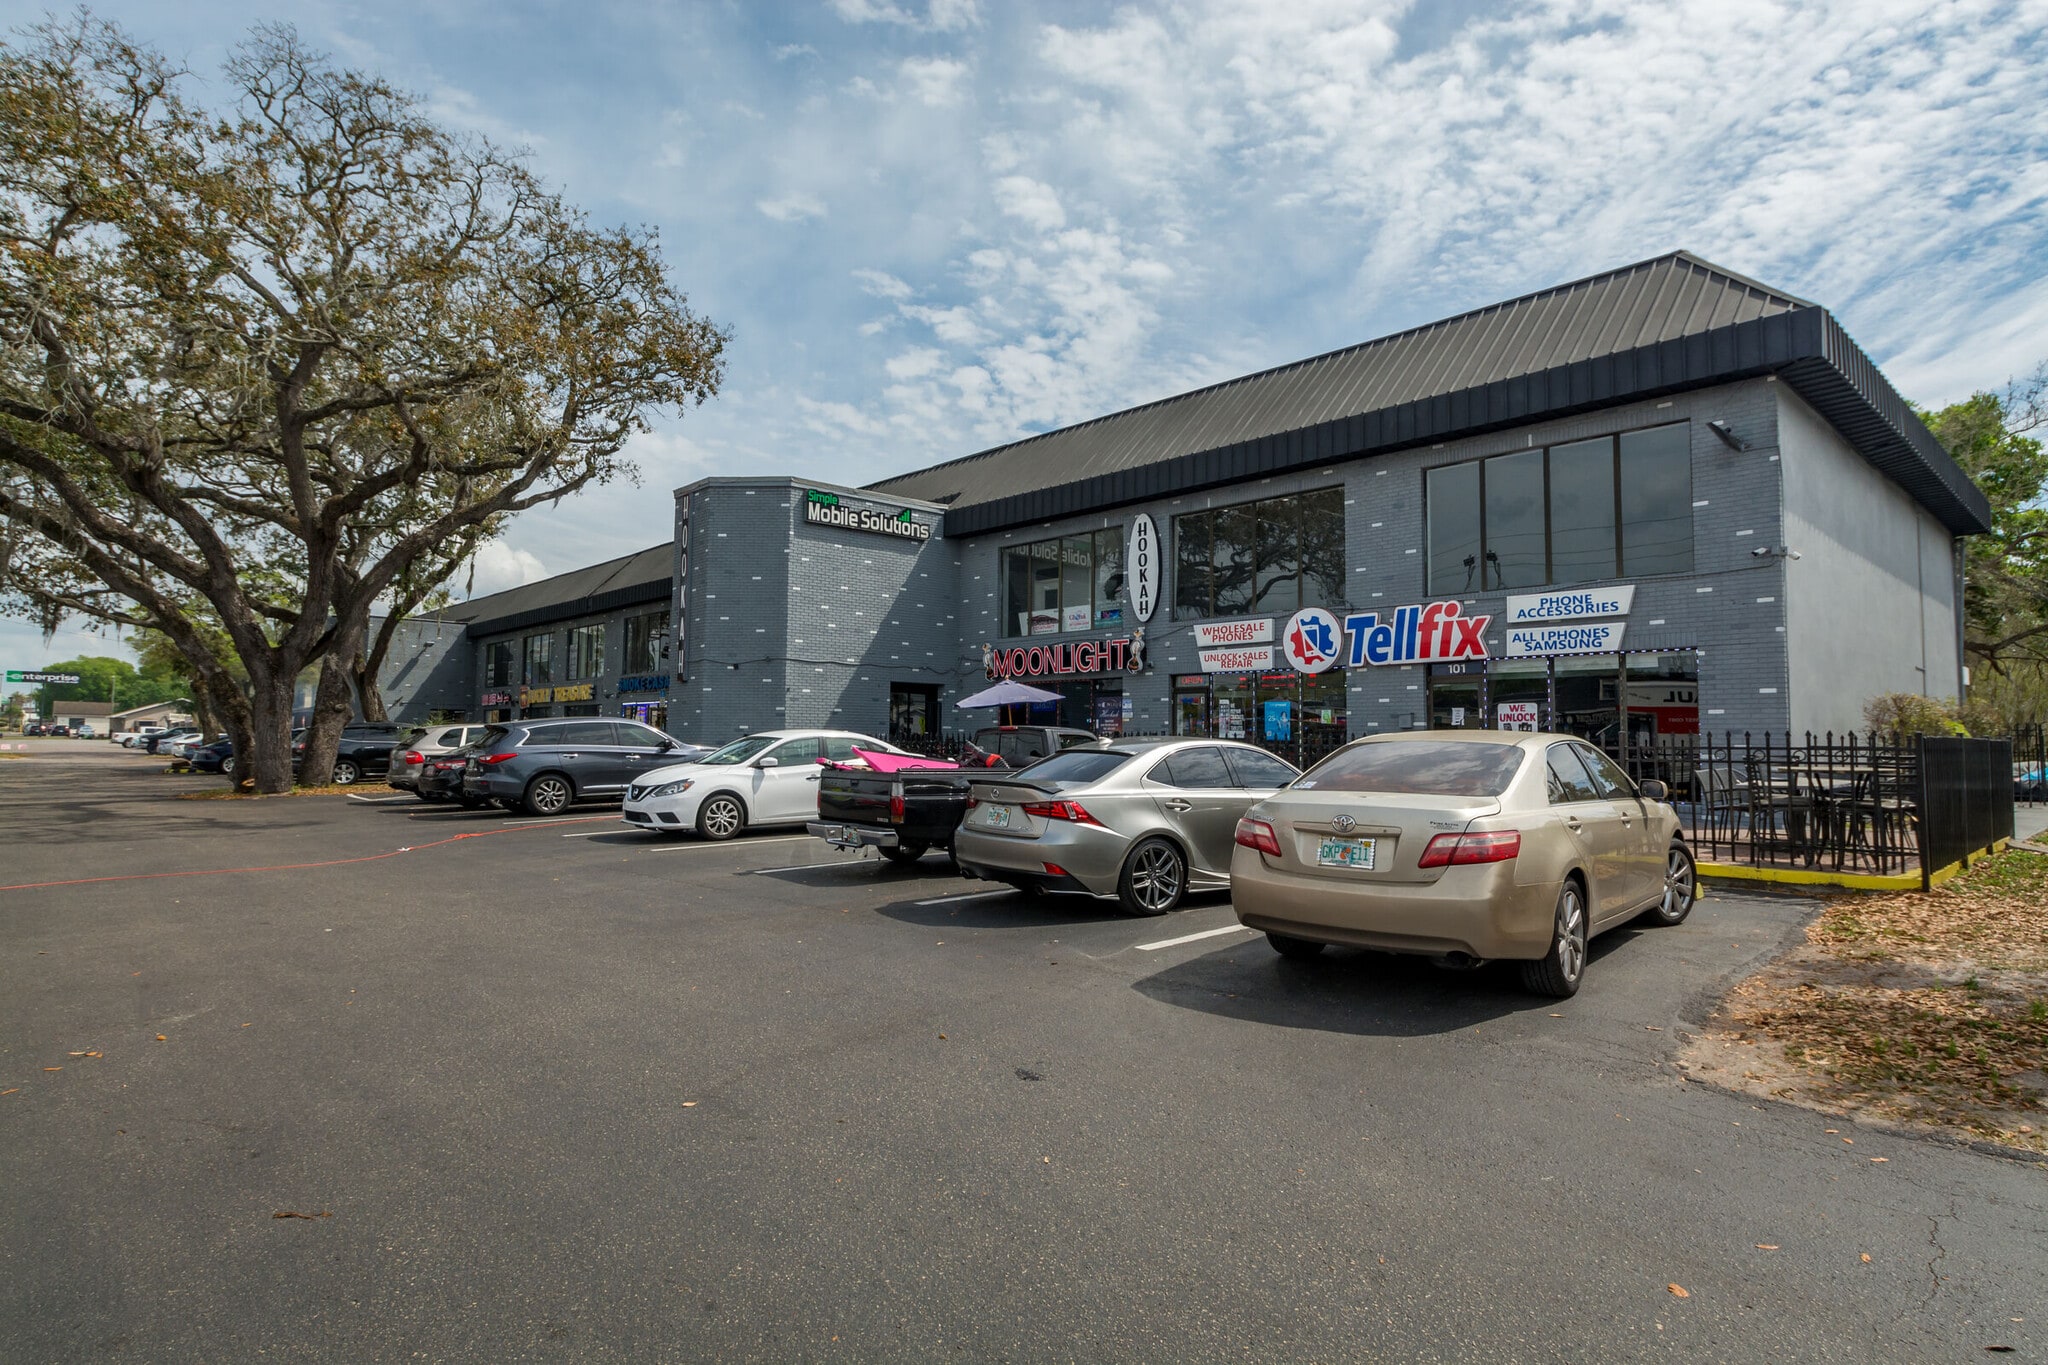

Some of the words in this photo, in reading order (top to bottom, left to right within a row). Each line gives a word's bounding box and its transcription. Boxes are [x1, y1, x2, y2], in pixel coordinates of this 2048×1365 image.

[808, 490, 838, 506] Simple
[808, 502, 858, 527] Mobile
[861, 511, 930, 539] Solutions
[1137, 522, 1149, 615] HOOKAH
[677, 495, 689, 674] HOOKAH
[1540, 594, 1593, 607] PHONE
[1517, 601, 1619, 619] ACCESSORIES
[1202, 621, 1265, 636] WHOLESALE
[1346, 602, 1488, 664] Tellfix
[1212, 631, 1254, 643] PHONES
[1512, 632, 1537, 643] ALL
[1524, 637, 1603, 652] SAMSUNG
[993, 639, 1130, 678] MOONLIGHT
[1221, 659, 1253, 669] REPAIR
[1448, 664, 1466, 675] 101
[1509, 704, 1526, 713] WE
[1499, 712, 1537, 723] UNLOCK
